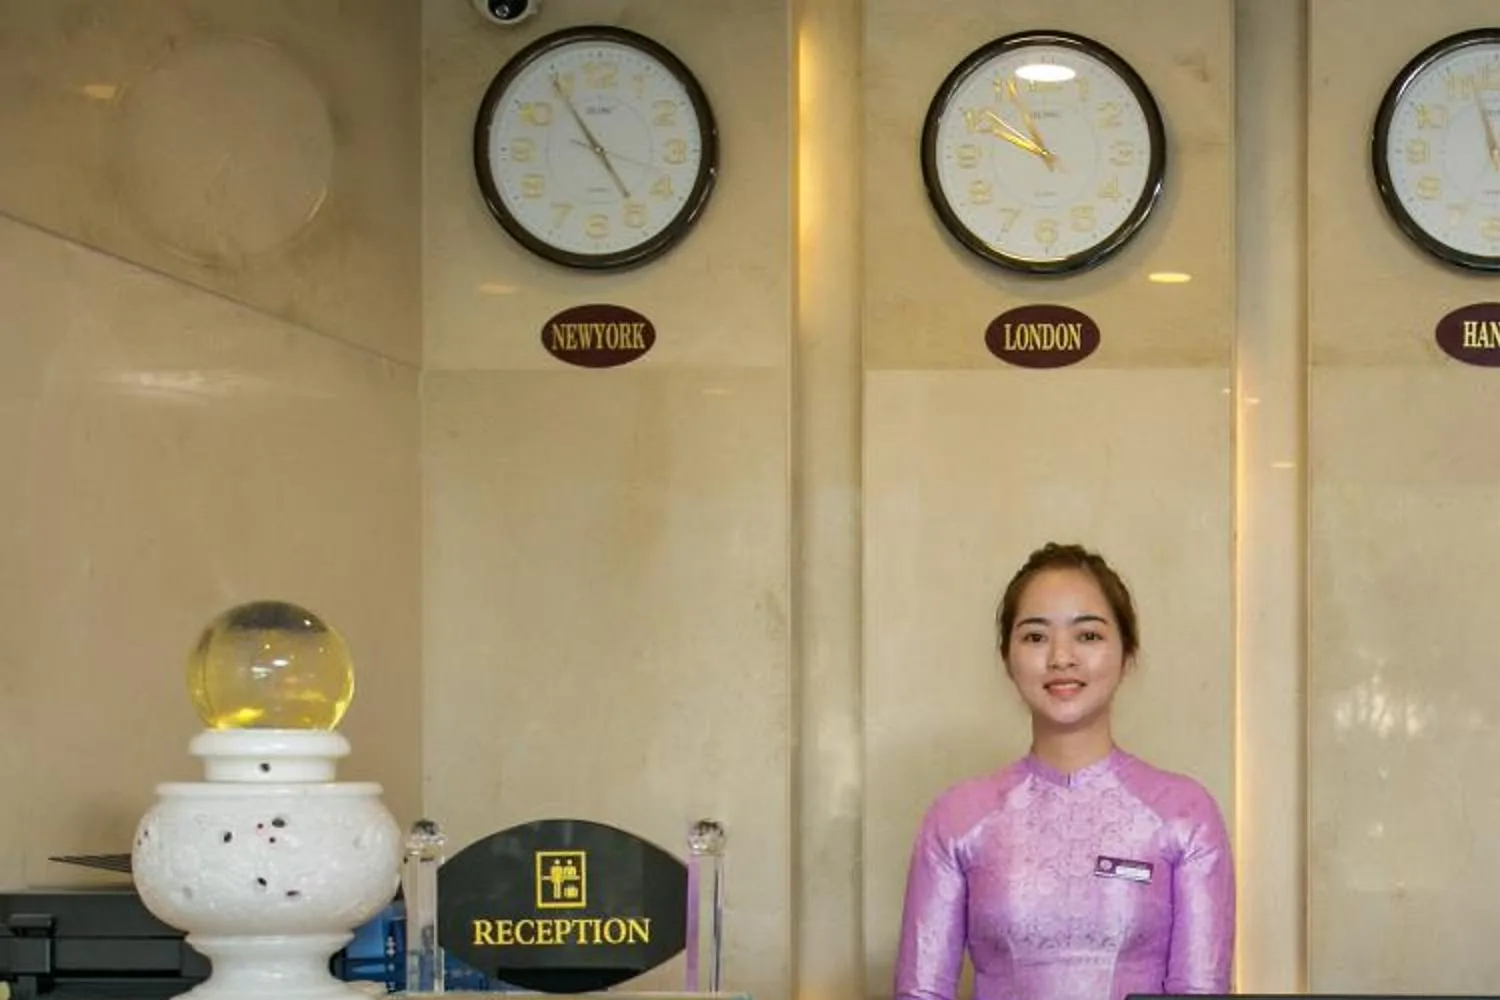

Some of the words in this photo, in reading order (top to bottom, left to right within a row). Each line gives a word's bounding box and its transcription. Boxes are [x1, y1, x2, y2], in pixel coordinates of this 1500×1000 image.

[552, 323, 645, 350] NEWYORK
[1004, 323, 1082, 351] LONDON
[473, 918, 651, 945] RECEPTION
